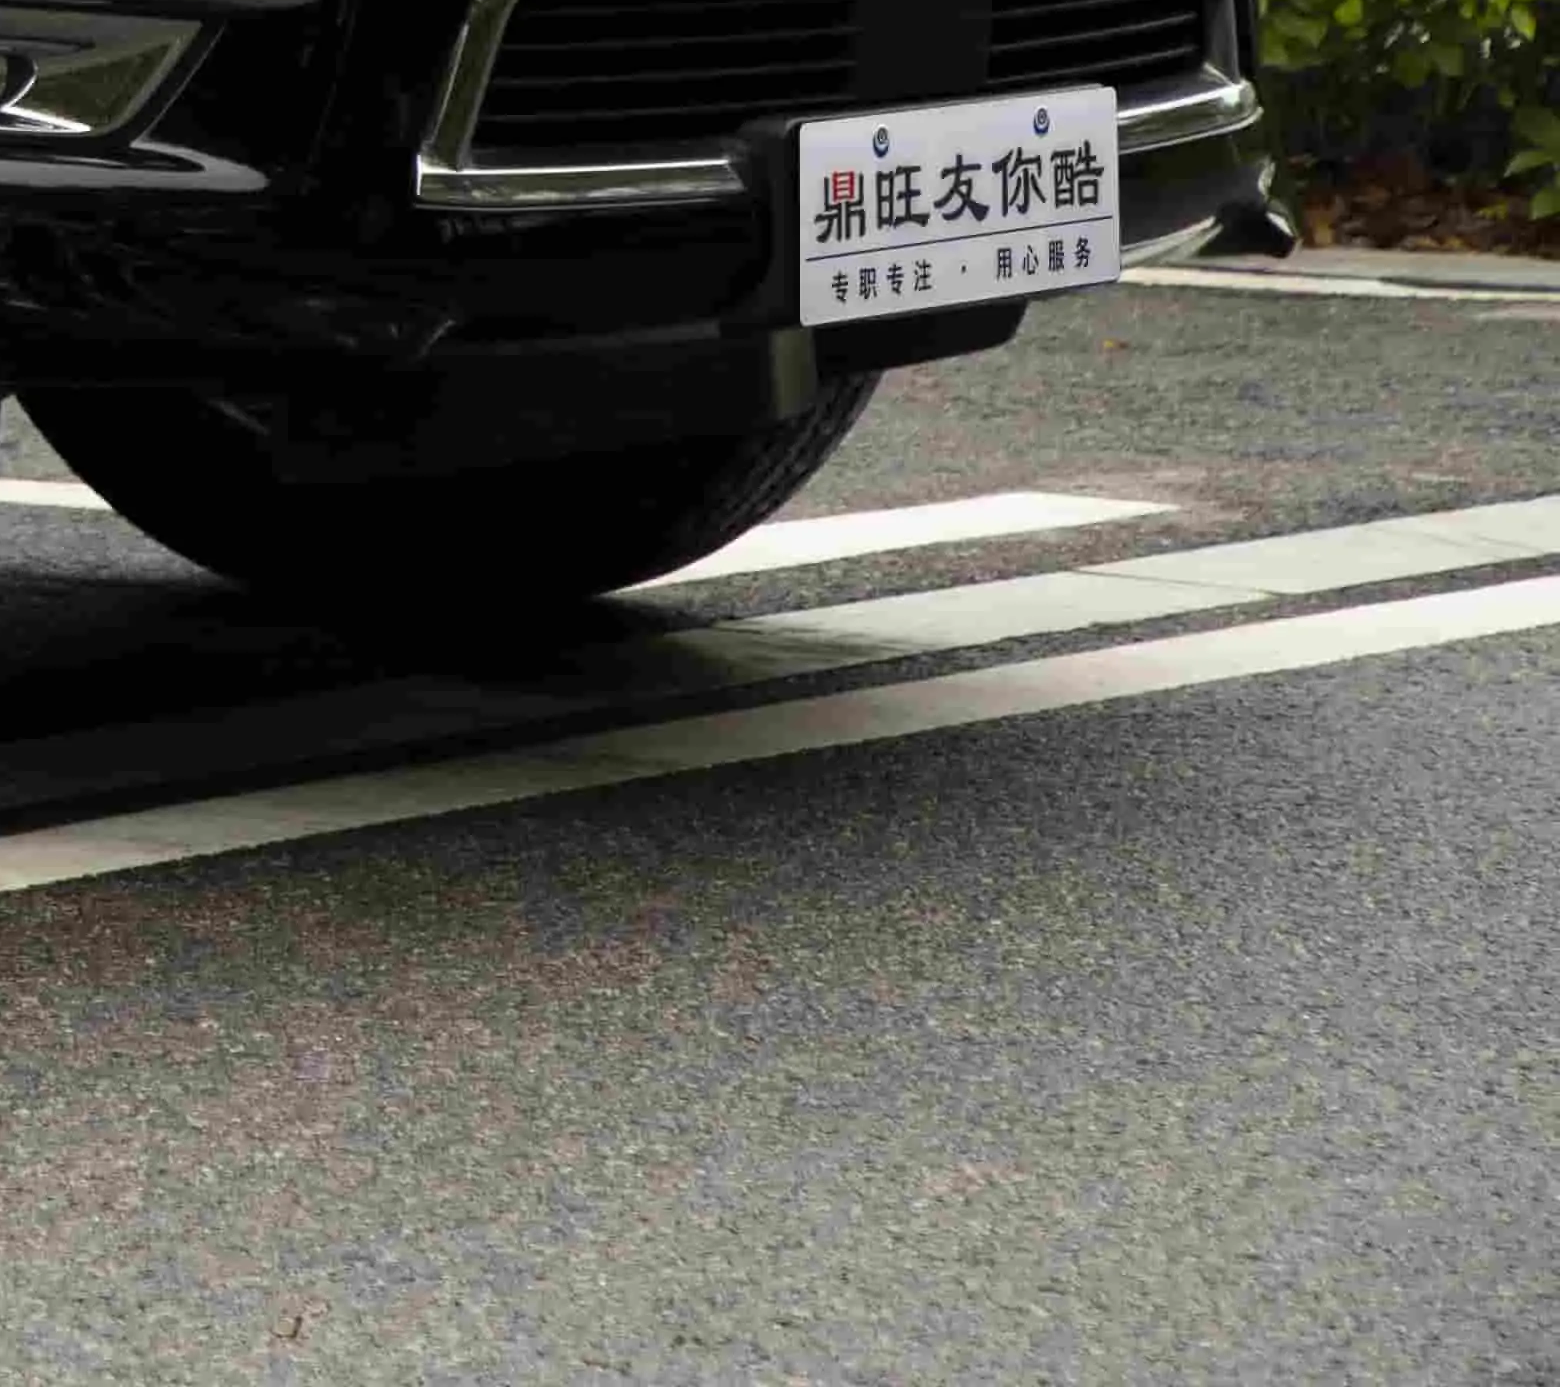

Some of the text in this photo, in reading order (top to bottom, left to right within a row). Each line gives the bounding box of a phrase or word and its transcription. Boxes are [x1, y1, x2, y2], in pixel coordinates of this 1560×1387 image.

[814, 140, 1105, 244] 鼎旺友你酷
[831, 236, 1092, 304] 专职专注 用心服务
